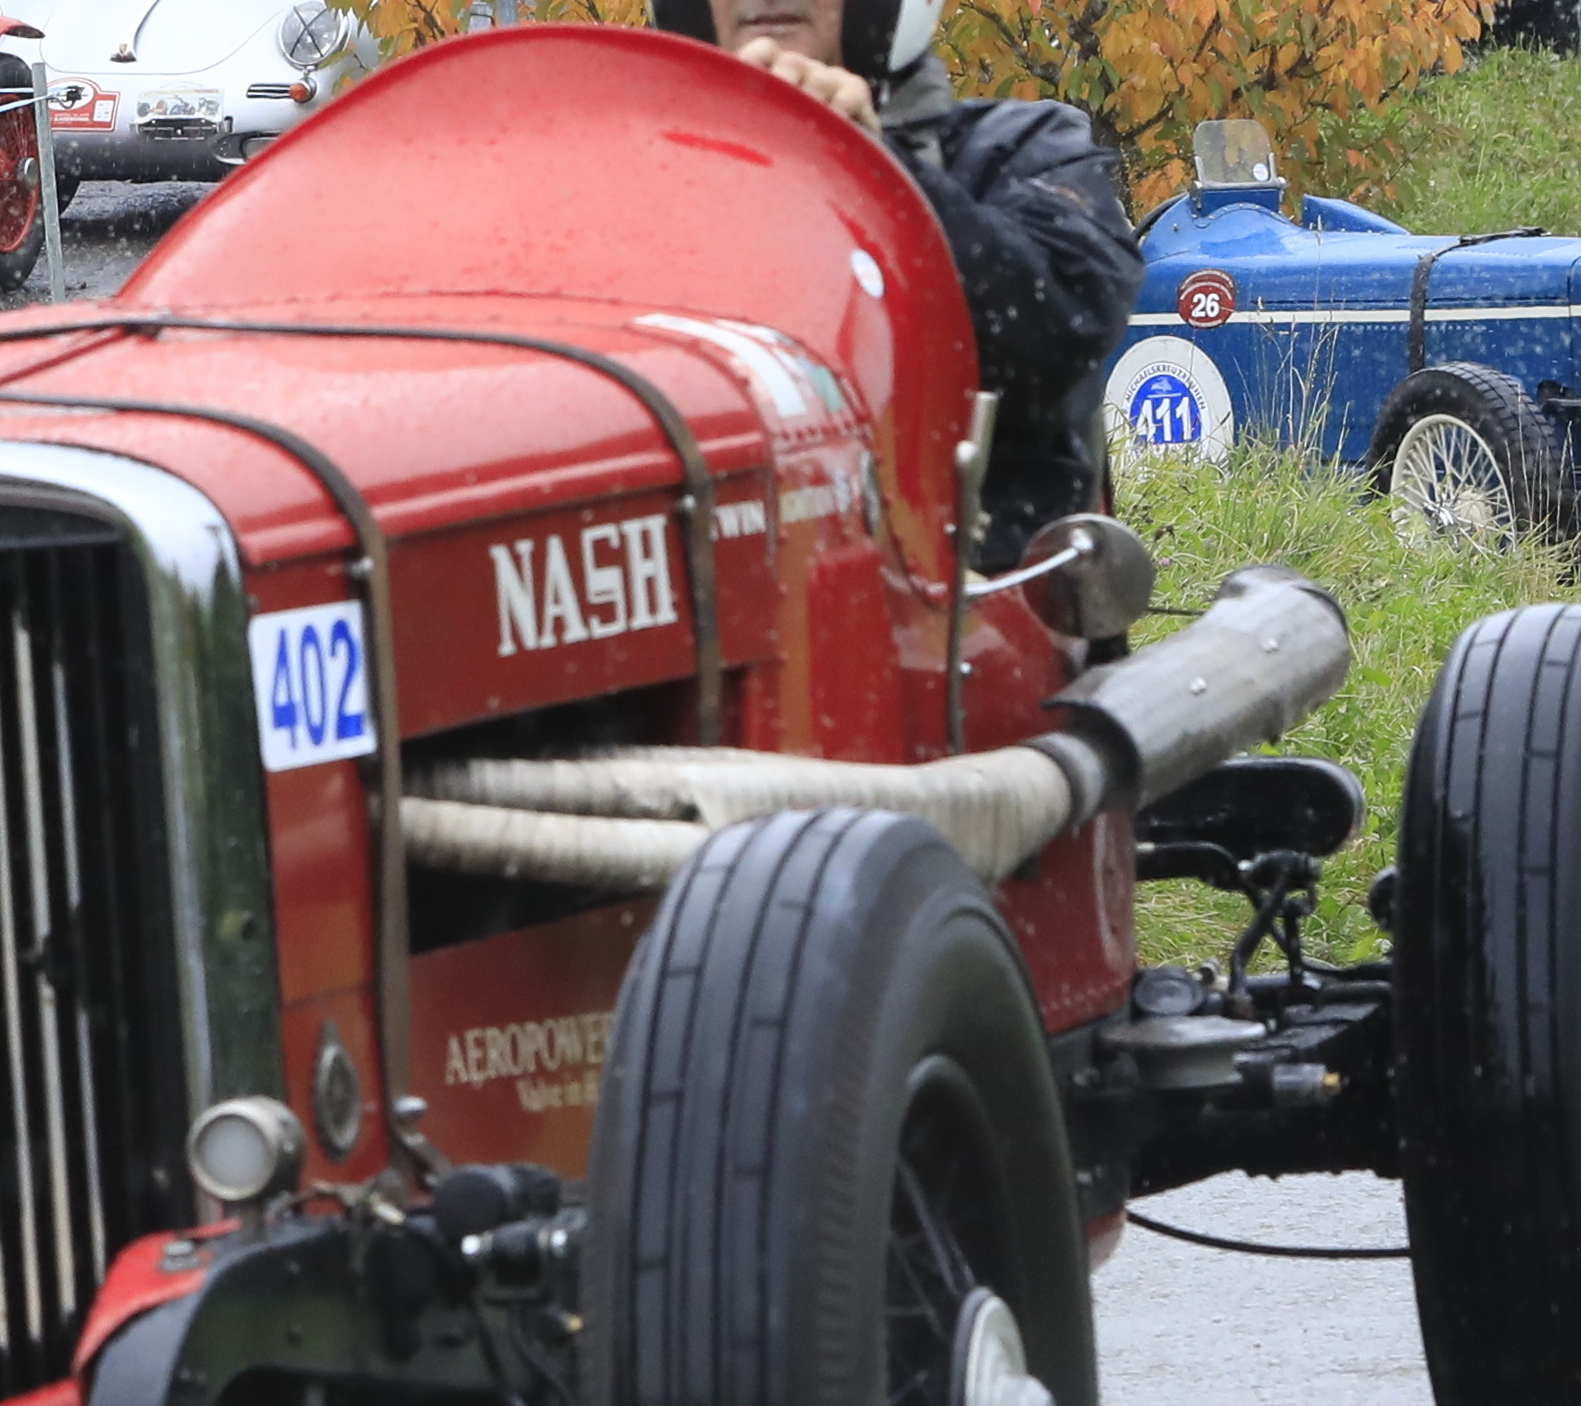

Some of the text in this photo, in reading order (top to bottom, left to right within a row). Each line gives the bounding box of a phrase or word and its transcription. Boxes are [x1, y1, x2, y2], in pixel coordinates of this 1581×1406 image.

[1191, 293, 1220, 318] 26
[1137, 396, 1192, 443] 411
[489, 514, 678, 657] NASH
[272, 619, 364, 749] 402
[444, 1011, 616, 1085] AEROPOWE
